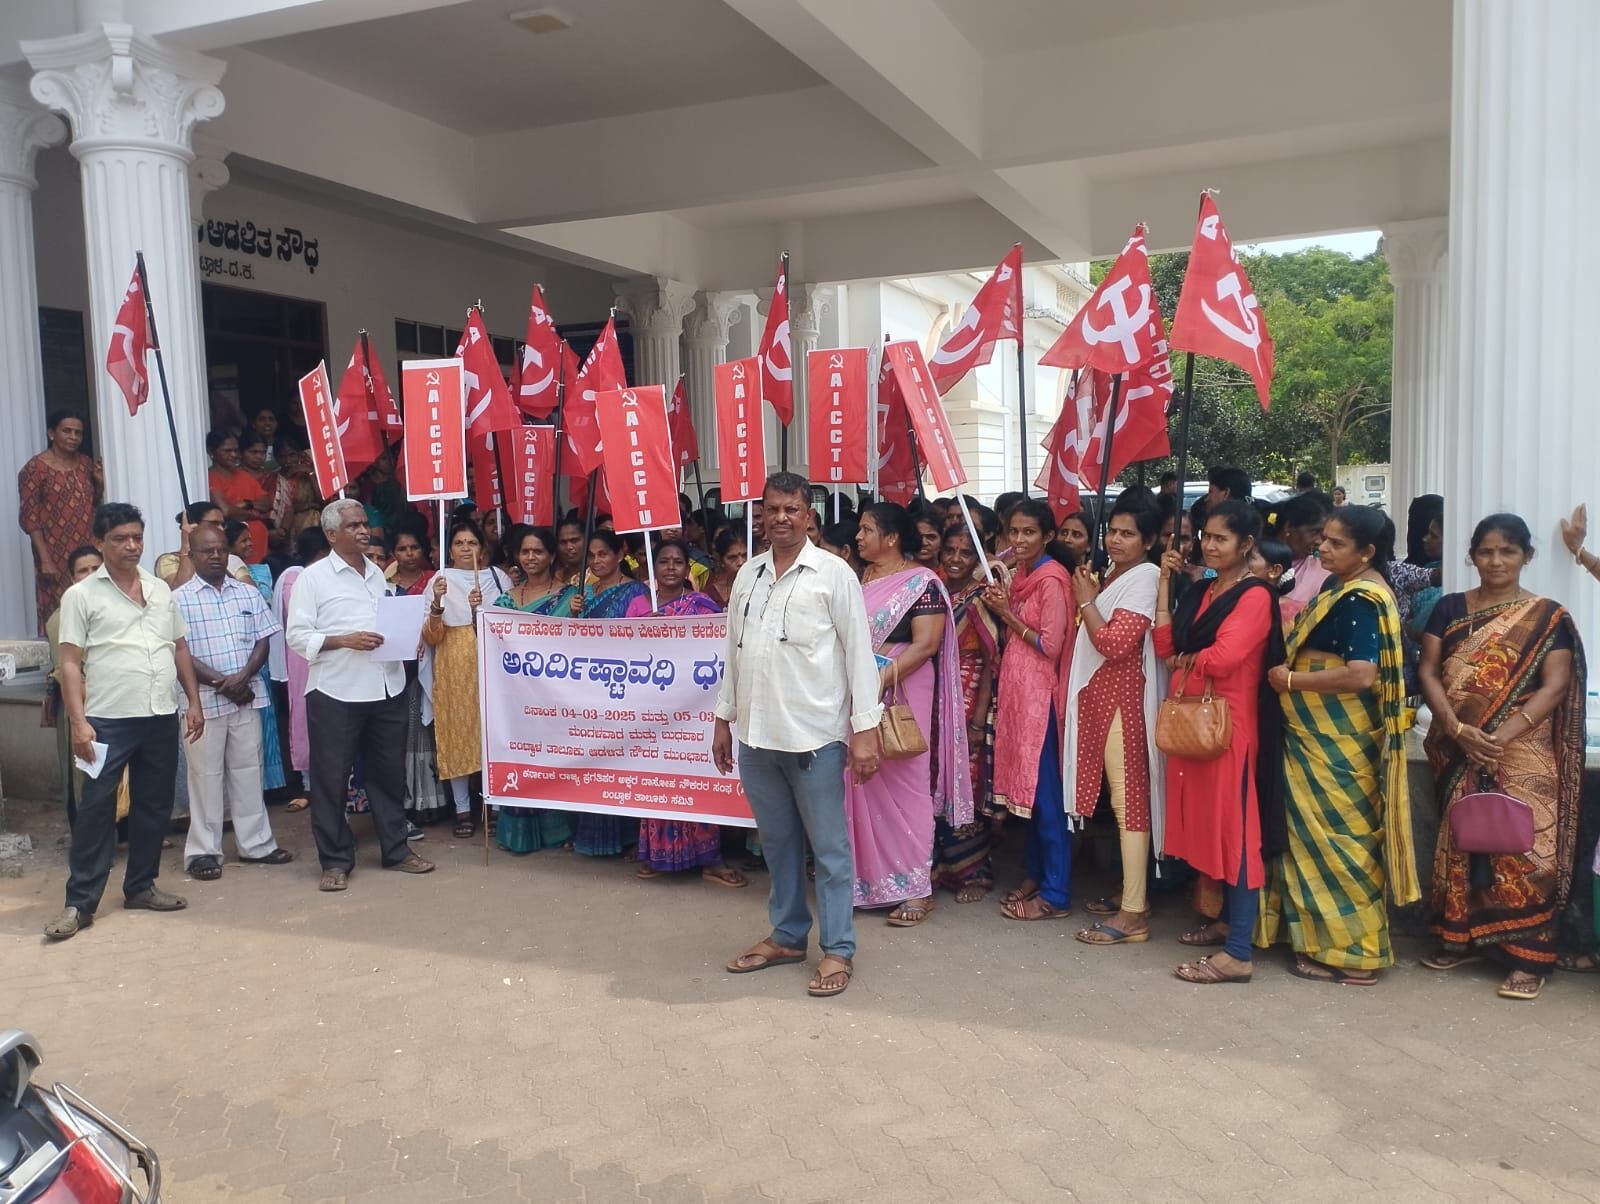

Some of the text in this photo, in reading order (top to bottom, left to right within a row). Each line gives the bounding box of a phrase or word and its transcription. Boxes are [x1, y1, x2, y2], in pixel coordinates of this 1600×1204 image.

[316, 391, 340, 490] AICCTU
[428, 389, 444, 492] AICCTU
[626, 411, 652, 525] AICCTU
[735, 384, 749, 496] AICCTU
[830, 373, 843, 482] AICCTU
[912, 368, 958, 484] AICCTU
[523, 444, 536, 526] AICCTU
[502, 651, 676, 700] ಅನಿರ್ದಿಷ್ಟಾವಧಿ
[692, 622, 727, 638] ಈಡೇರಿ
[561, 707, 636, 722] 04-03-2025
[673, 711, 715, 723] 05-03
